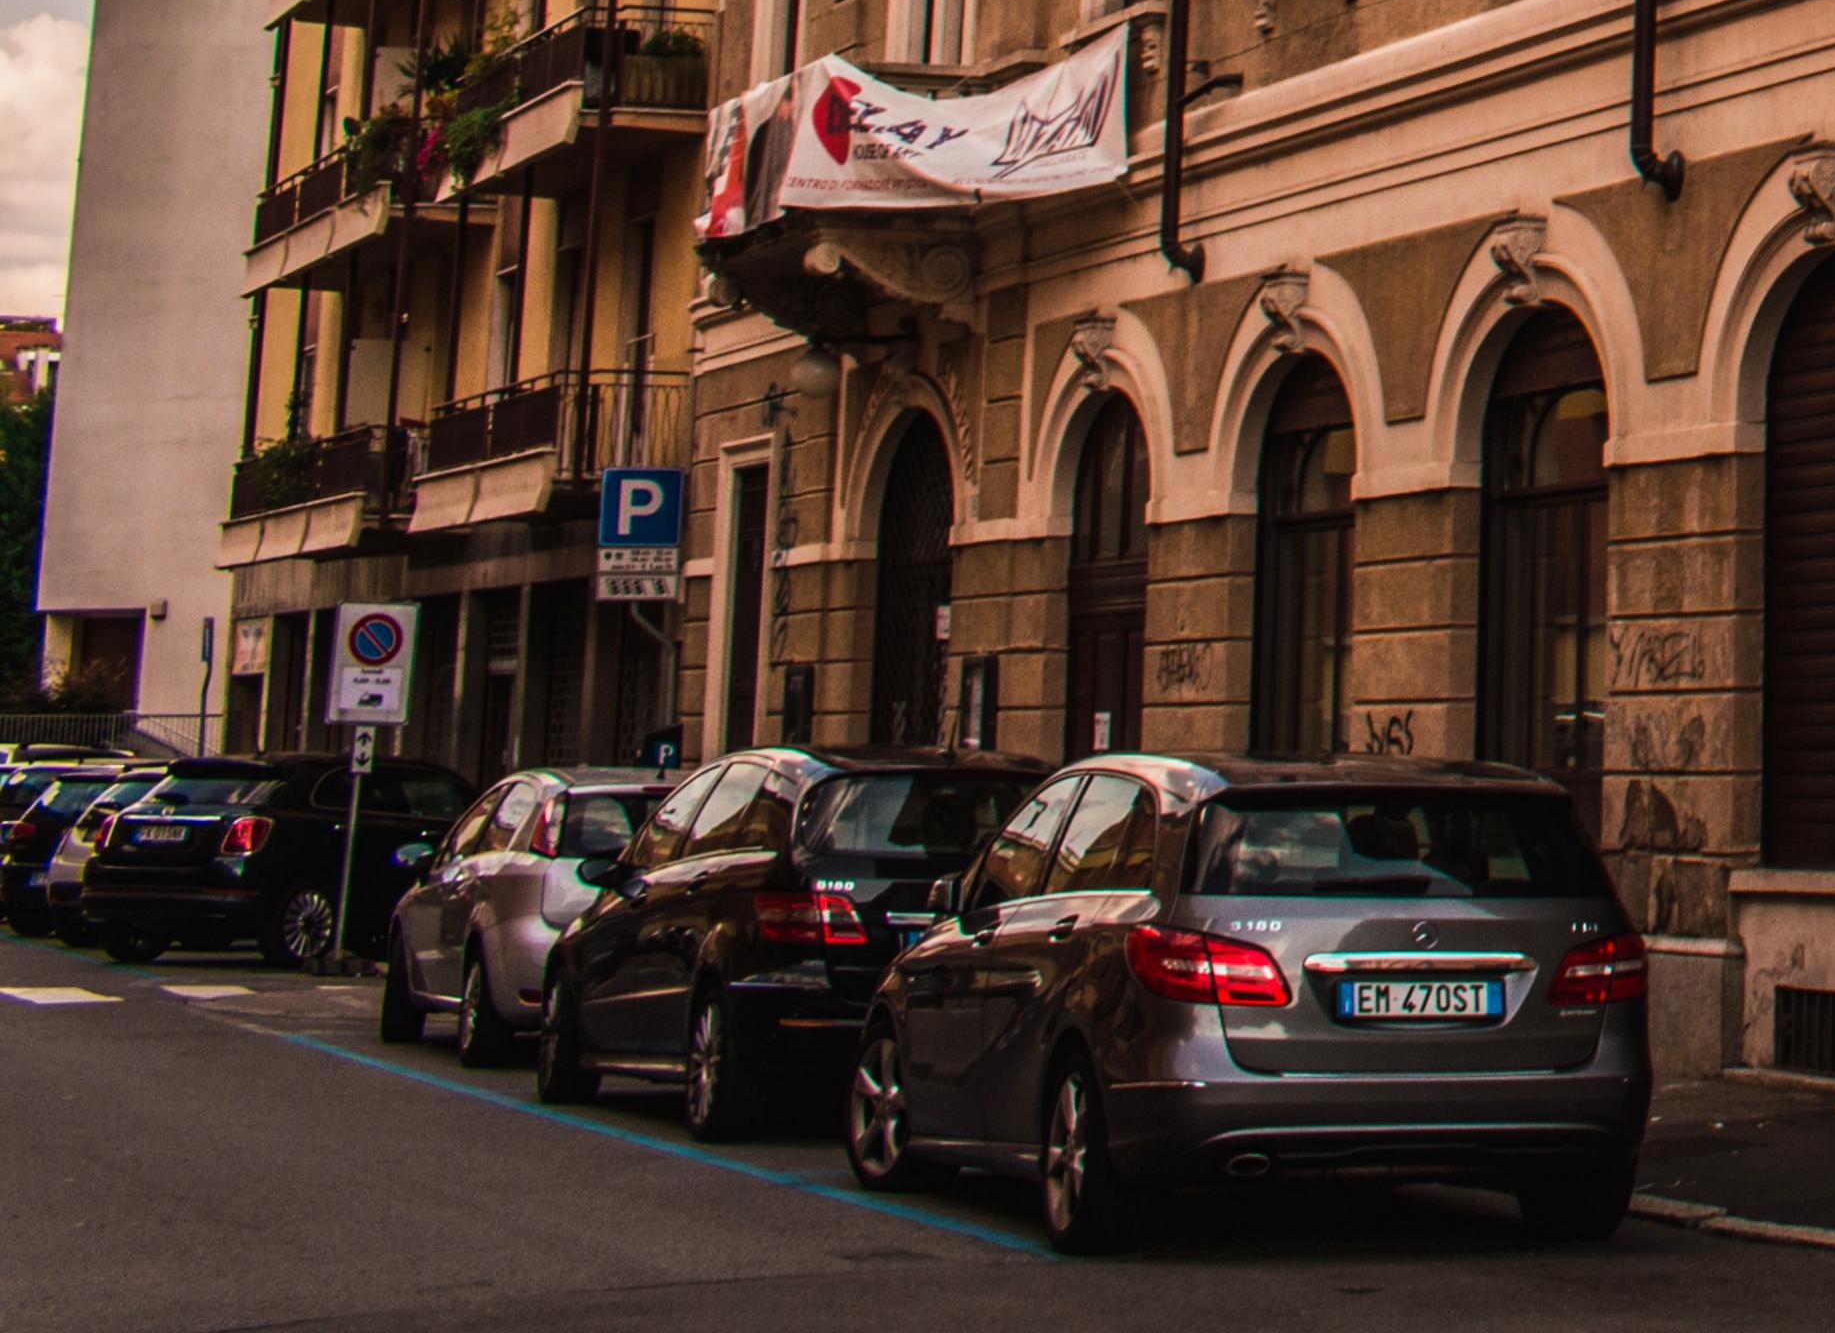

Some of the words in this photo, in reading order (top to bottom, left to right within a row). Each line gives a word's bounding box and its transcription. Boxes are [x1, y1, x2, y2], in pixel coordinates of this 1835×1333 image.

[617, 478, 664, 536] P
[1357, 985, 1389, 1013] EM
[1402, 984, 1486, 1013] 470ST
